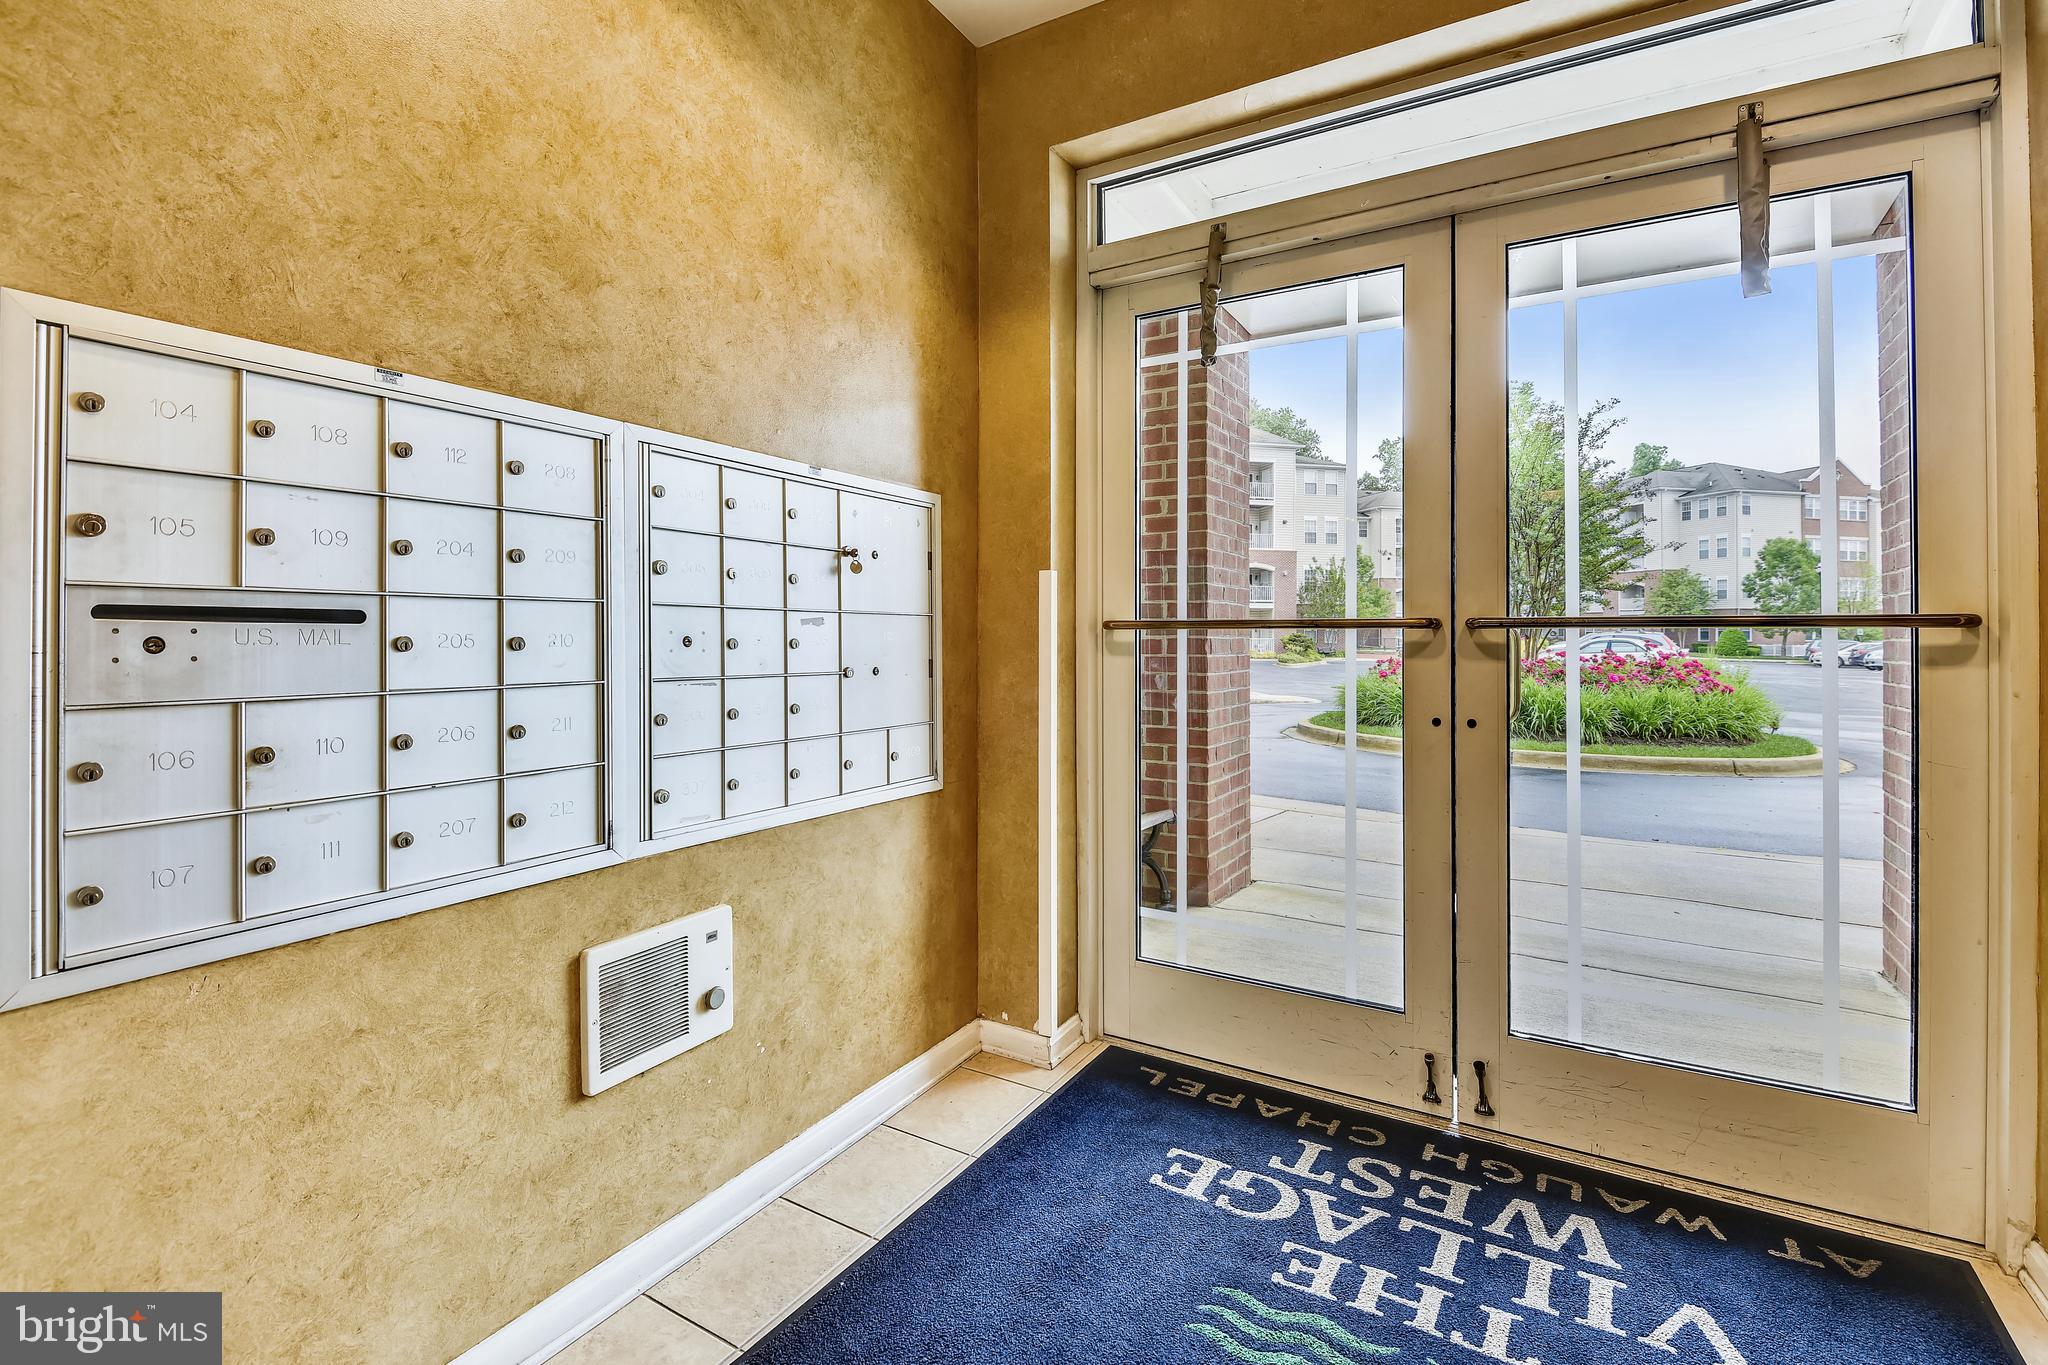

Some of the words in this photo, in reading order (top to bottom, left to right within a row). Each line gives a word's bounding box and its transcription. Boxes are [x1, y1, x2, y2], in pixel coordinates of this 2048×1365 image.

[150, 399, 198, 422] 104
[311, 424, 349, 445] 108
[445, 447, 467, 464] 112
[544, 463, 576, 480] 208
[150, 516, 196, 537] 105
[312, 528, 349, 547] 109
[436, 539, 474, 557] 204
[544, 549, 577, 564] 209
[233, 627, 279, 646] U.S.
[298, 628, 351, 646] MAIL
[437, 633, 475, 649] 205
[548, 633, 574, 648] 210
[551, 716, 573, 732] 211
[437, 725, 475, 743] 206
[315, 736, 345, 755] 110
[149, 750, 195, 771] 106
[549, 800, 574, 818] 212
[439, 817, 476, 838] 207
[320, 840, 341, 859] 111
[150, 864, 195, 890] 107
[1140, 1065, 1387, 1147] CHAPEL
[1421, 1142, 1727, 1242] WAUGH
[1268, 1138, 1623, 1270] WEST
[1149, 1147, 1746, 1365] VILLAGE
[1767, 1236, 1883, 1278] AT
[1271, 1241, 1544, 1365] THE
